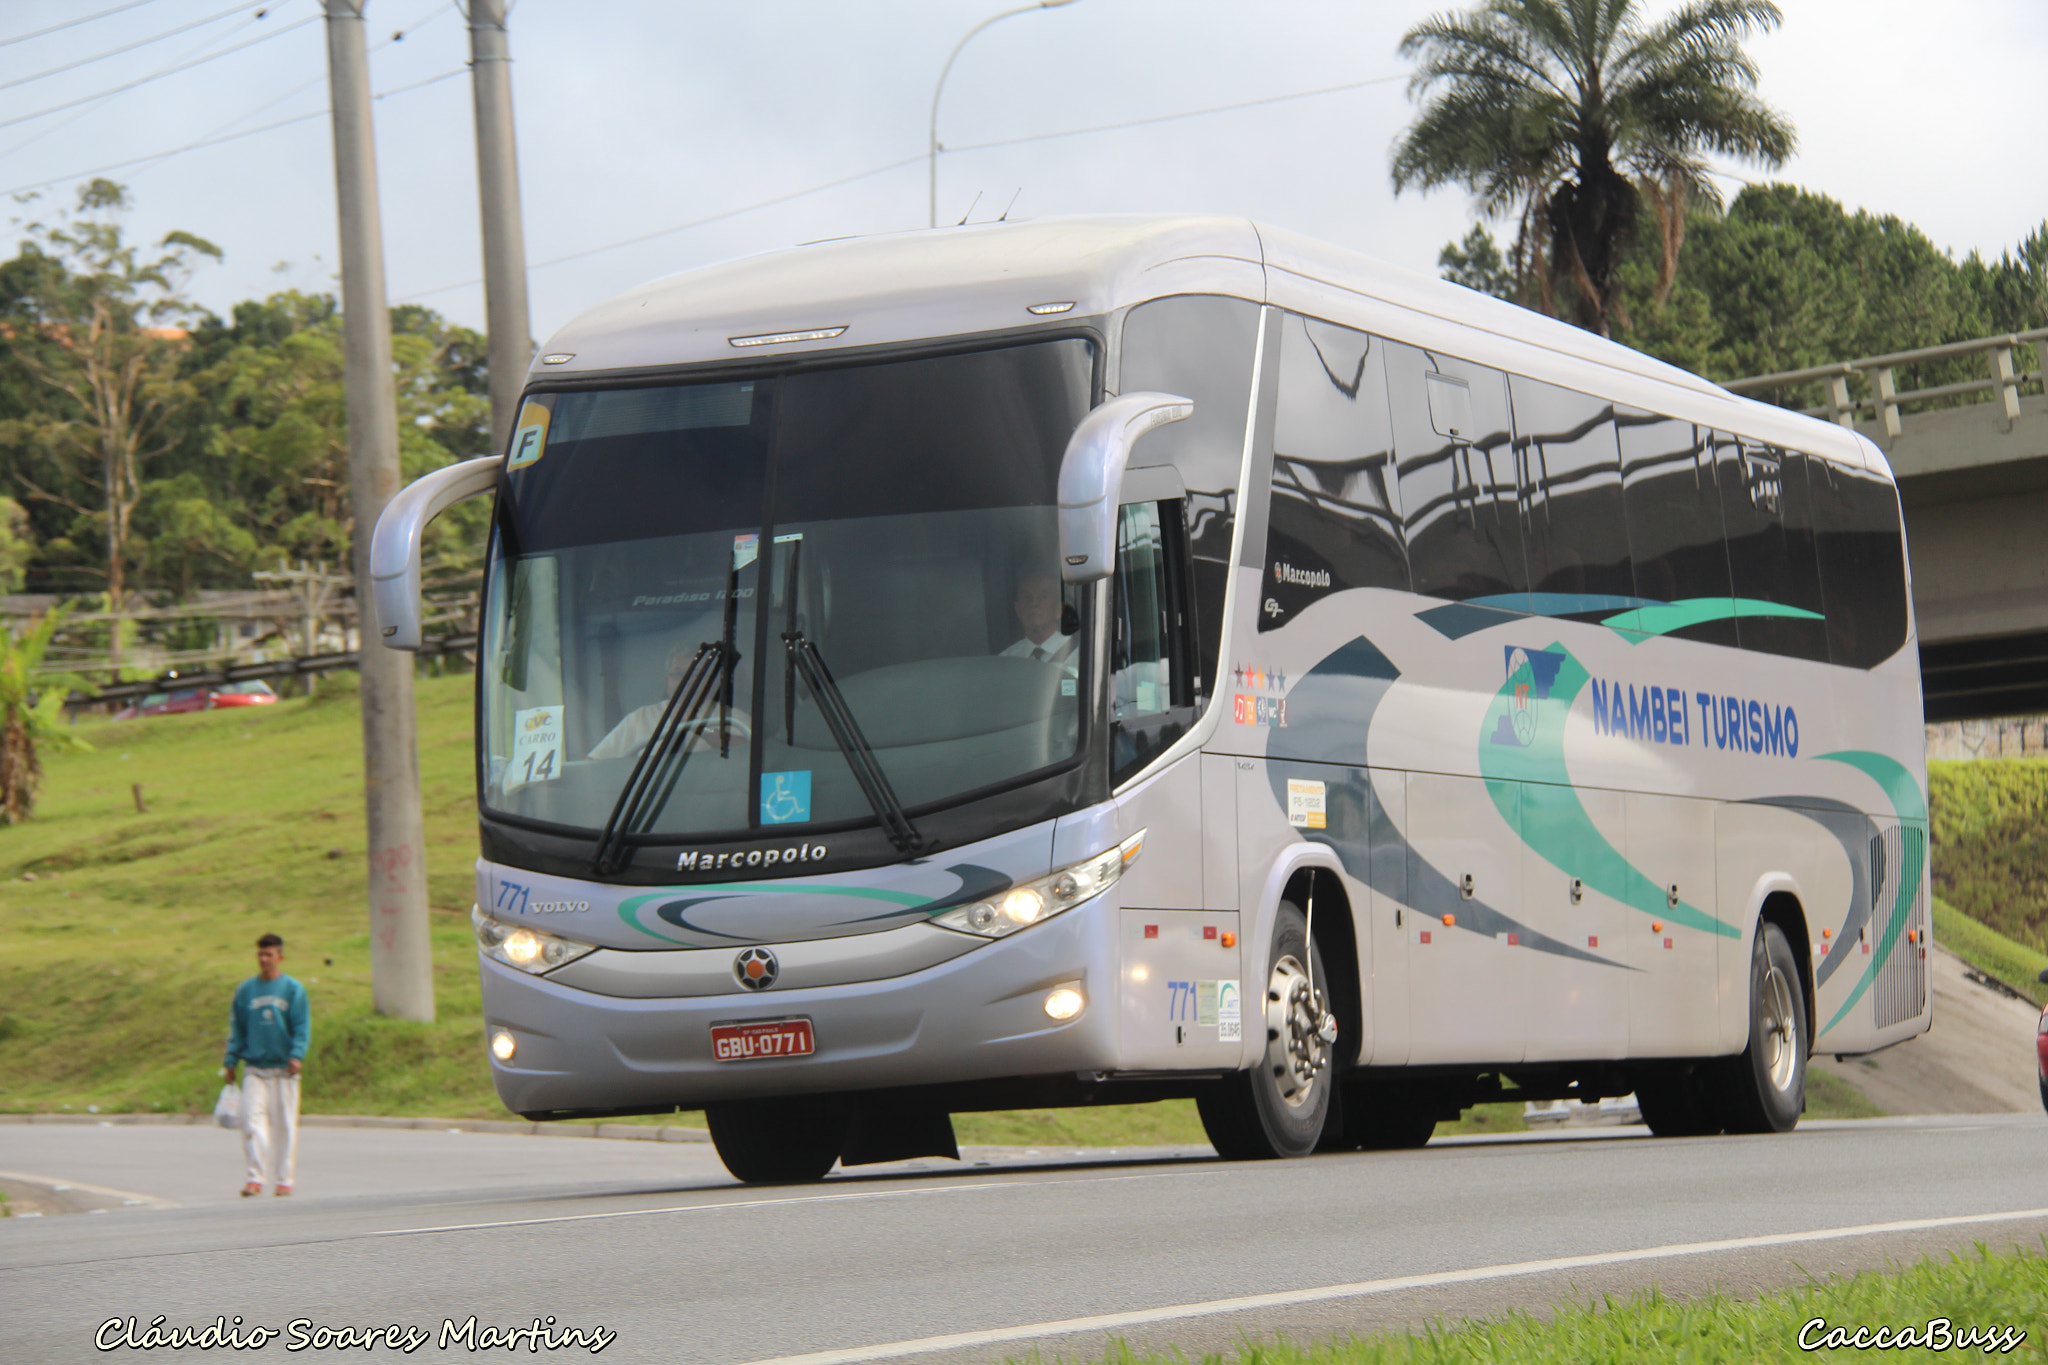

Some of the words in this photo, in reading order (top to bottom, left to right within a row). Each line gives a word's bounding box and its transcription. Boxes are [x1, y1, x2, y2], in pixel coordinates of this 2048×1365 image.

[516, 430, 538, 460] F
[1282, 562, 1331, 588] Marcopolo
[632, 592, 711, 606] Paradiso
[1515, 684, 1530, 710] NT
[1591, 676, 1690, 747] NAMBEI
[1695, 691, 1800, 760] TURISMO
[519, 732, 556, 746] CARRO
[523, 748, 556, 782] 14
[676, 843, 828, 872] Marcopolo
[496, 880, 531, 915] 771
[530, 899, 591, 915] VOLVO
[1167, 981, 1198, 1021] 771
